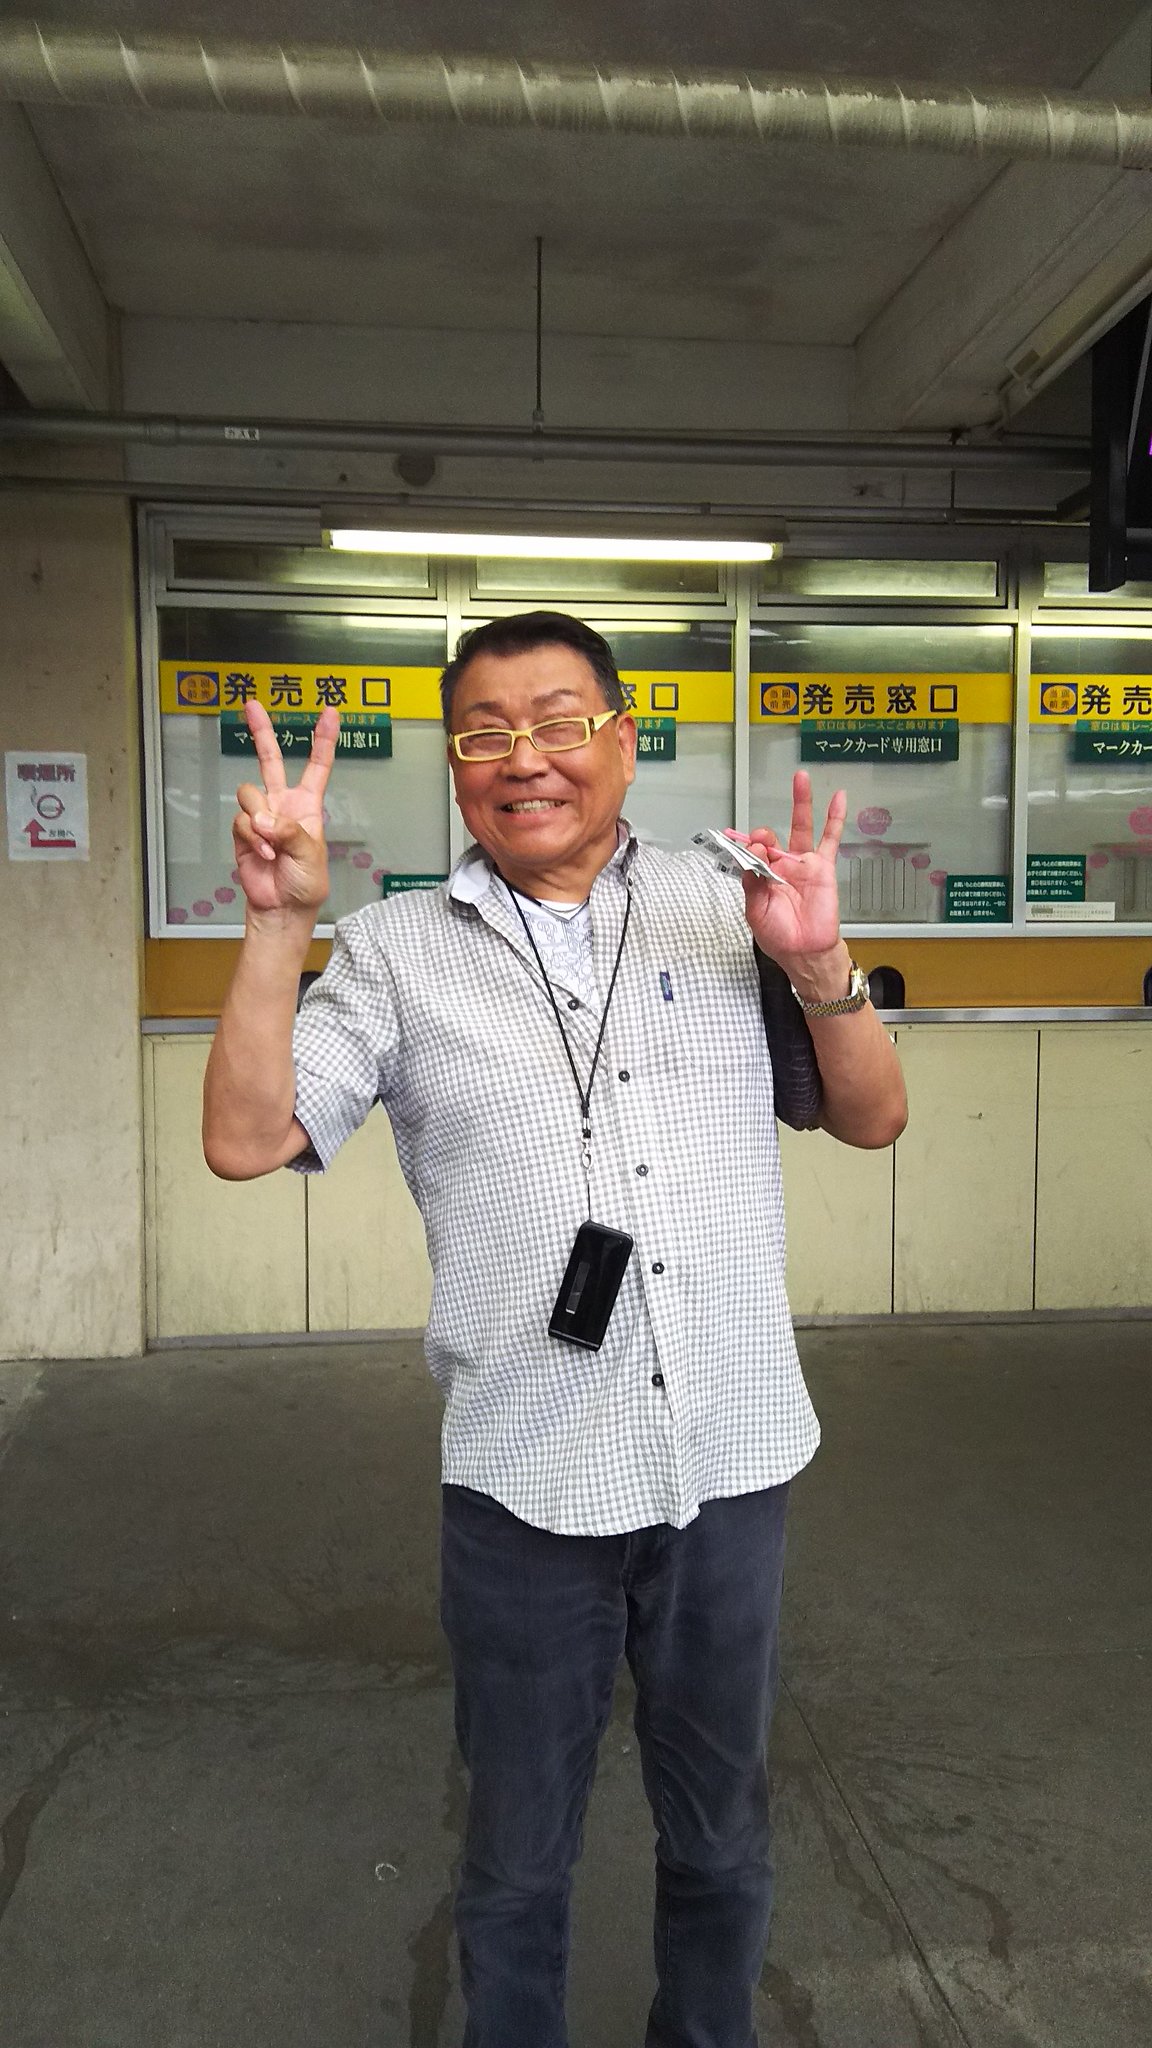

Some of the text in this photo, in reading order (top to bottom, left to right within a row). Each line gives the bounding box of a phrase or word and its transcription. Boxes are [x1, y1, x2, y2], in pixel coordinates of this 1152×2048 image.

[224, 672, 391, 707] 発売窓口
[803, 683, 958, 715] 発売窓口
[1082, 684, 1152, 715] 発売
[1090, 721, 1152, 732] 窓口は毎レー
[815, 736, 942, 754] マークカード専用窓口
